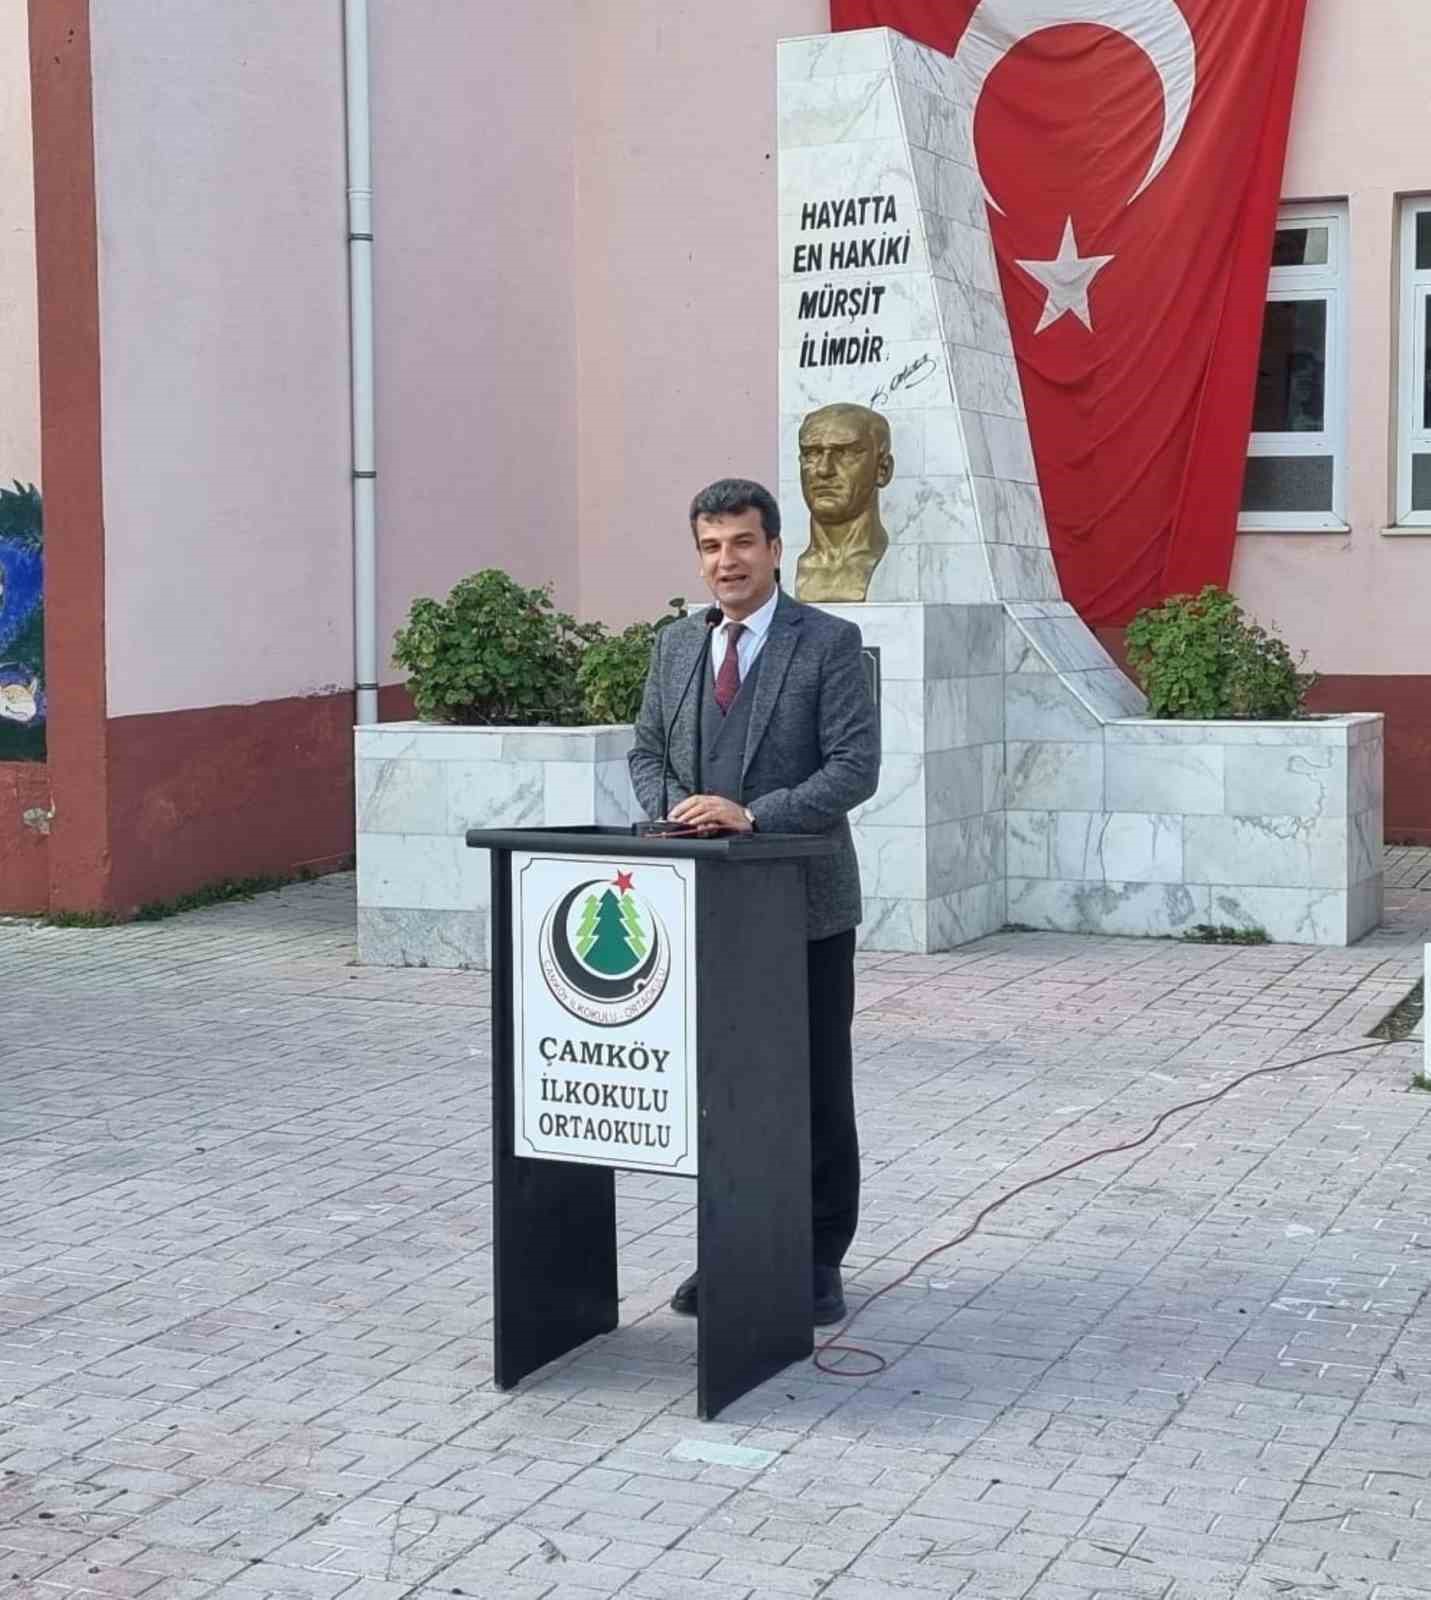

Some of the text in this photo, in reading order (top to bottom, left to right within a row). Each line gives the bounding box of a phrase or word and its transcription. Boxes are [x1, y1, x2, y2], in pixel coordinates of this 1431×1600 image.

[801, 195, 896, 230] HAYATTA
[793, 228, 911, 273] EN HAKİKİ
[798, 281, 886, 323] MÜRŞİT
[799, 327, 883, 368] İLİMDİR
[539, 1036, 671, 1073] ÇAMKÖY
[541, 1072, 668, 1113] İLKOKULU
[539, 1112, 671, 1148] ORTAOKULU
